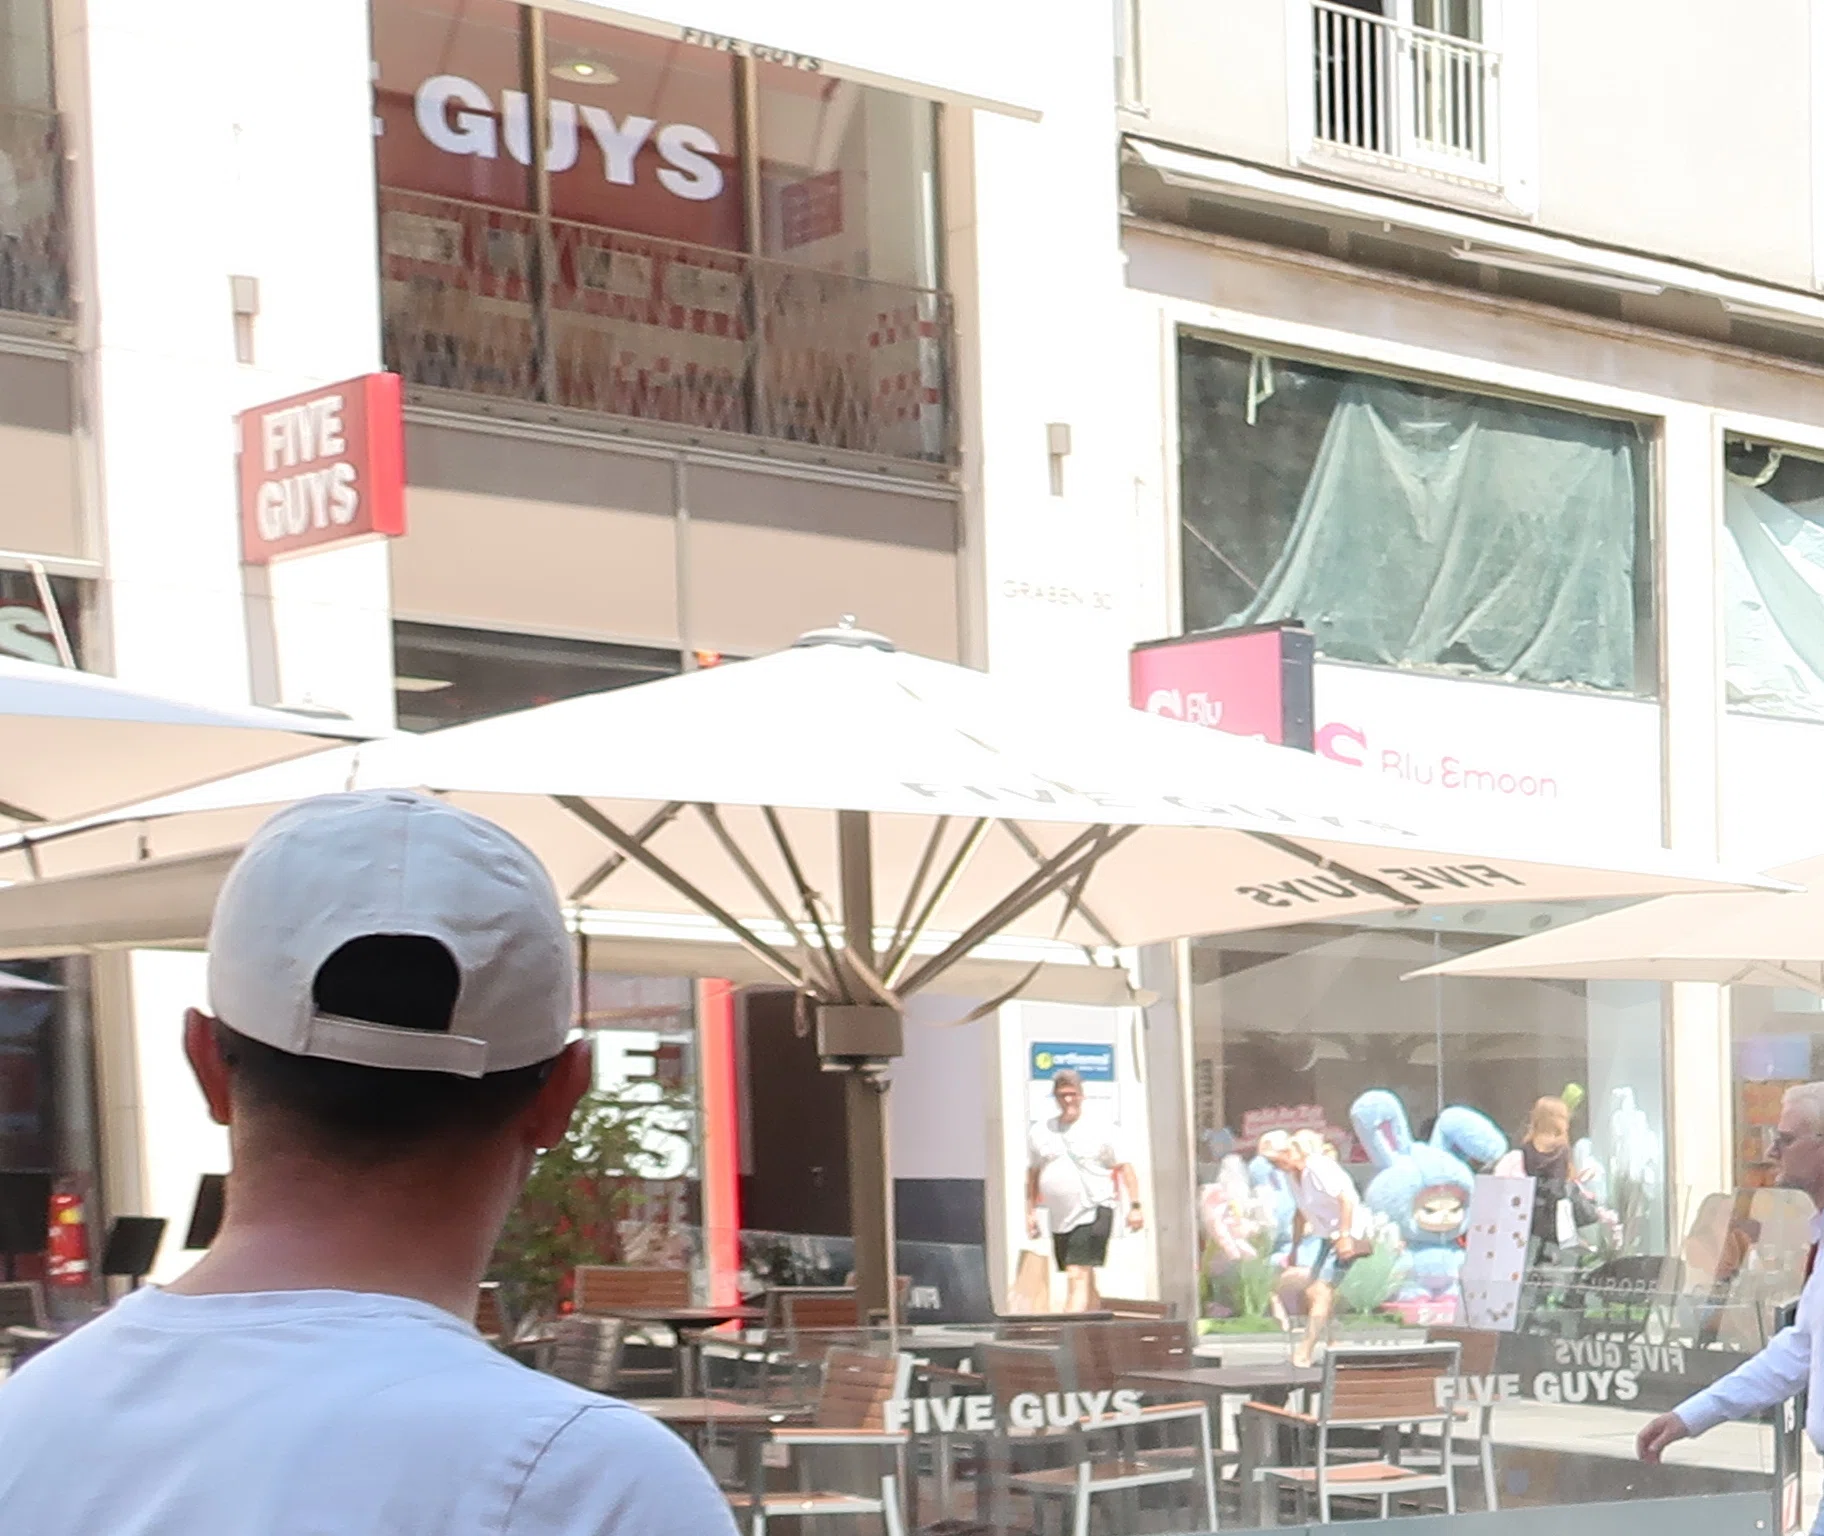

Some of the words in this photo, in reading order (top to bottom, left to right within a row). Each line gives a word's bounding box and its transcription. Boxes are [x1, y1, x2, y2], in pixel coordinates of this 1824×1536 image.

[415, 74, 724, 201] GUYS
[261, 394, 346, 472] FIVE
[256, 461, 360, 541] GUYS
[883, 1394, 996, 1434] FIVE
[1009, 1388, 1144, 1432] GUYS
[1434, 1374, 1523, 1408] FIVE
[1533, 1368, 1640, 1402] GUYS
